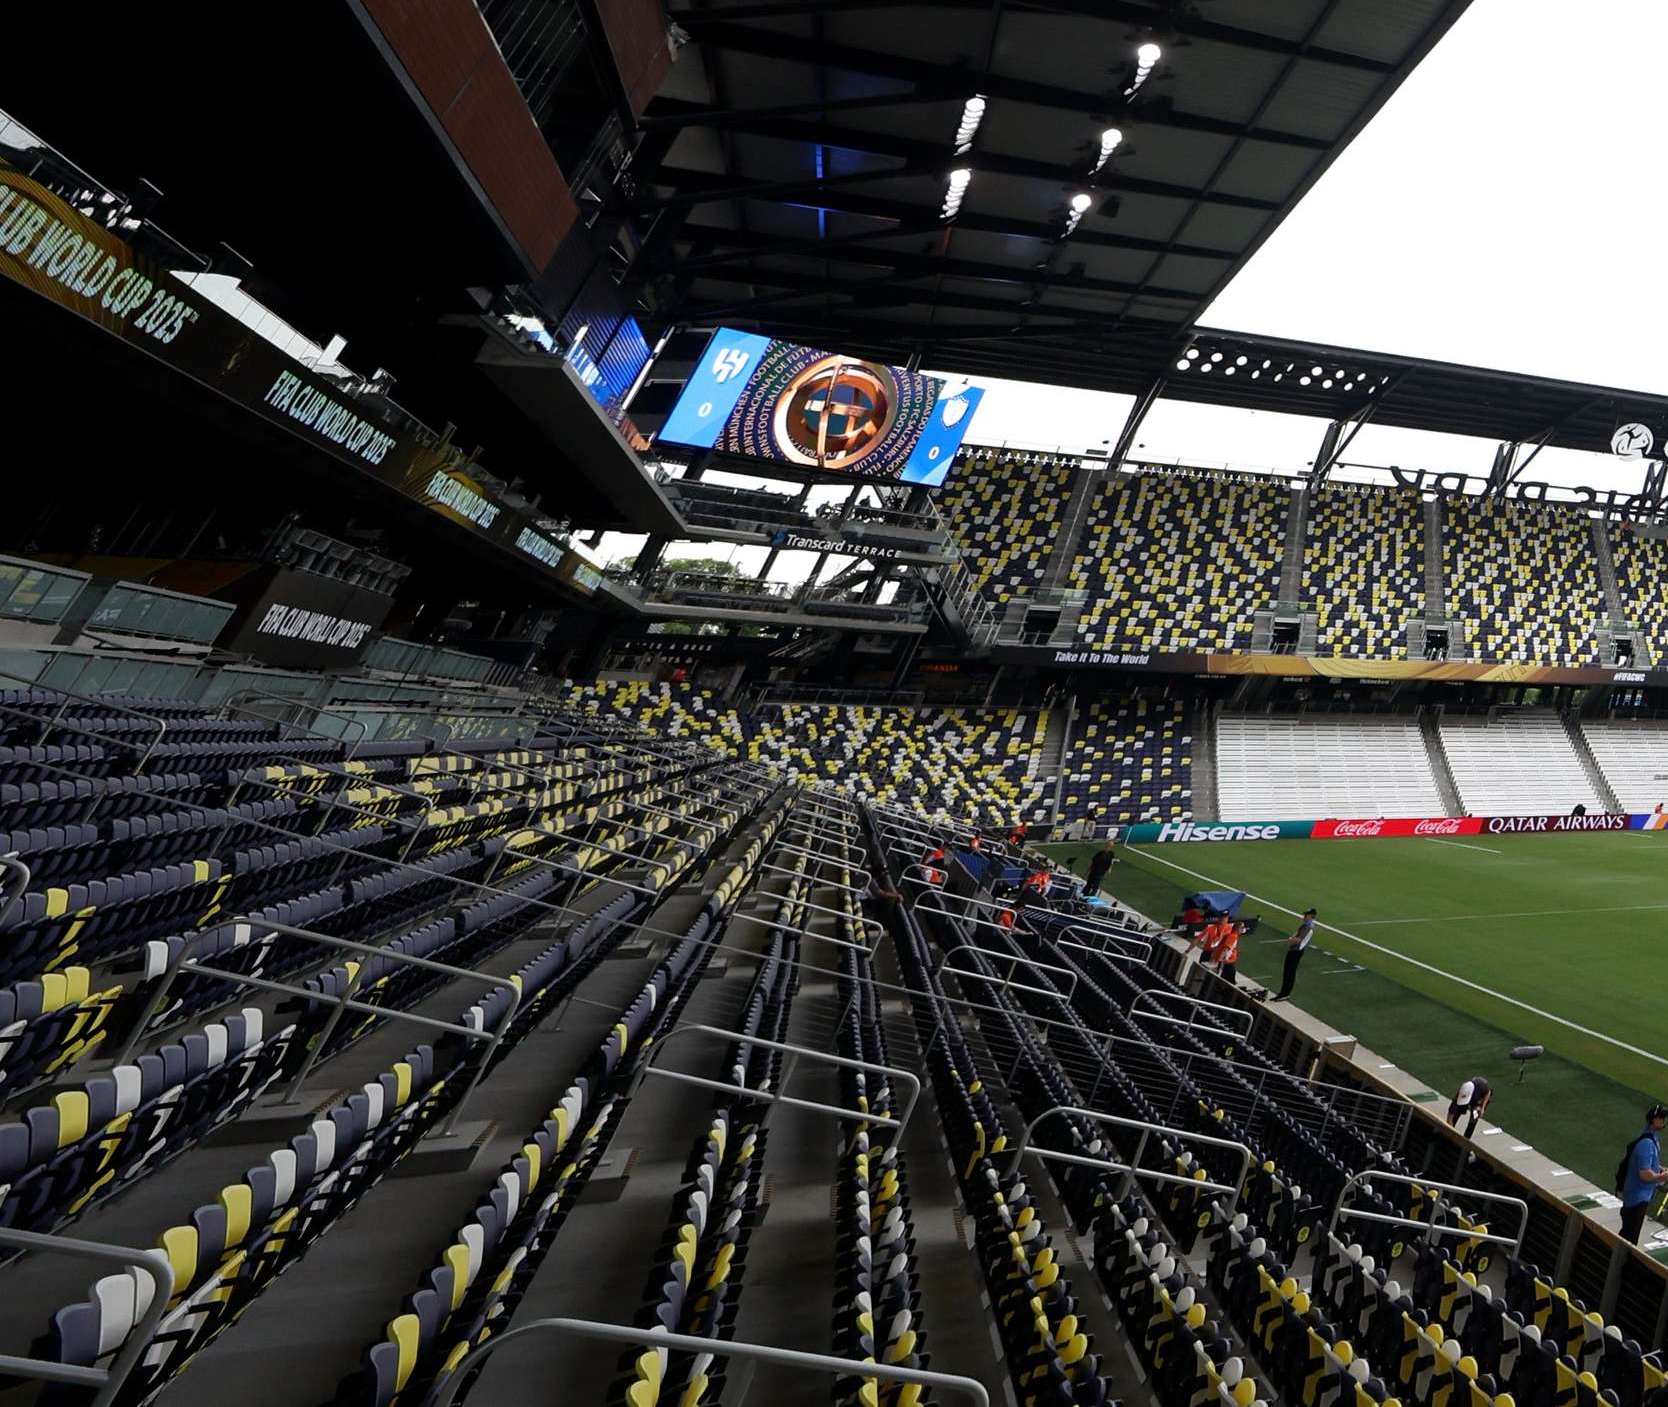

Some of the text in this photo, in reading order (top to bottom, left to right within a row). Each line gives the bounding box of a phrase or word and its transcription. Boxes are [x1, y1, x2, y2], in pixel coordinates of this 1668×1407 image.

[0, 184, 48, 255] LUB
[27, 219, 117, 297] WORLD
[101, 268, 152, 318] CUP
[750, 346, 790, 386] FOOTBALL
[777, 359, 789, 373] DE
[758, 385, 782, 429] FOOTBALL
[781, 361, 805, 383] CLUB
[264, 370, 302, 412] FIFA
[289, 385, 327, 425] CLUB
[313, 399, 358, 443] WORLD
[346, 421, 374, 453] CUP
[853, 452, 878, 472] CLUB
[786, 534, 902, 559] Transcard TERRACE
[257, 603, 289, 634] FIFA
[278, 608, 310, 638] CLUB
[1055, 651, 1077, 663] Take
[1089, 653, 1100, 663] To
[1102, 653, 1120, 664] The
[1121, 654, 1149, 665] World
[1157, 823, 1280, 843] Hisense
[1488, 814, 1625, 834] QATAR AIRWAYS
